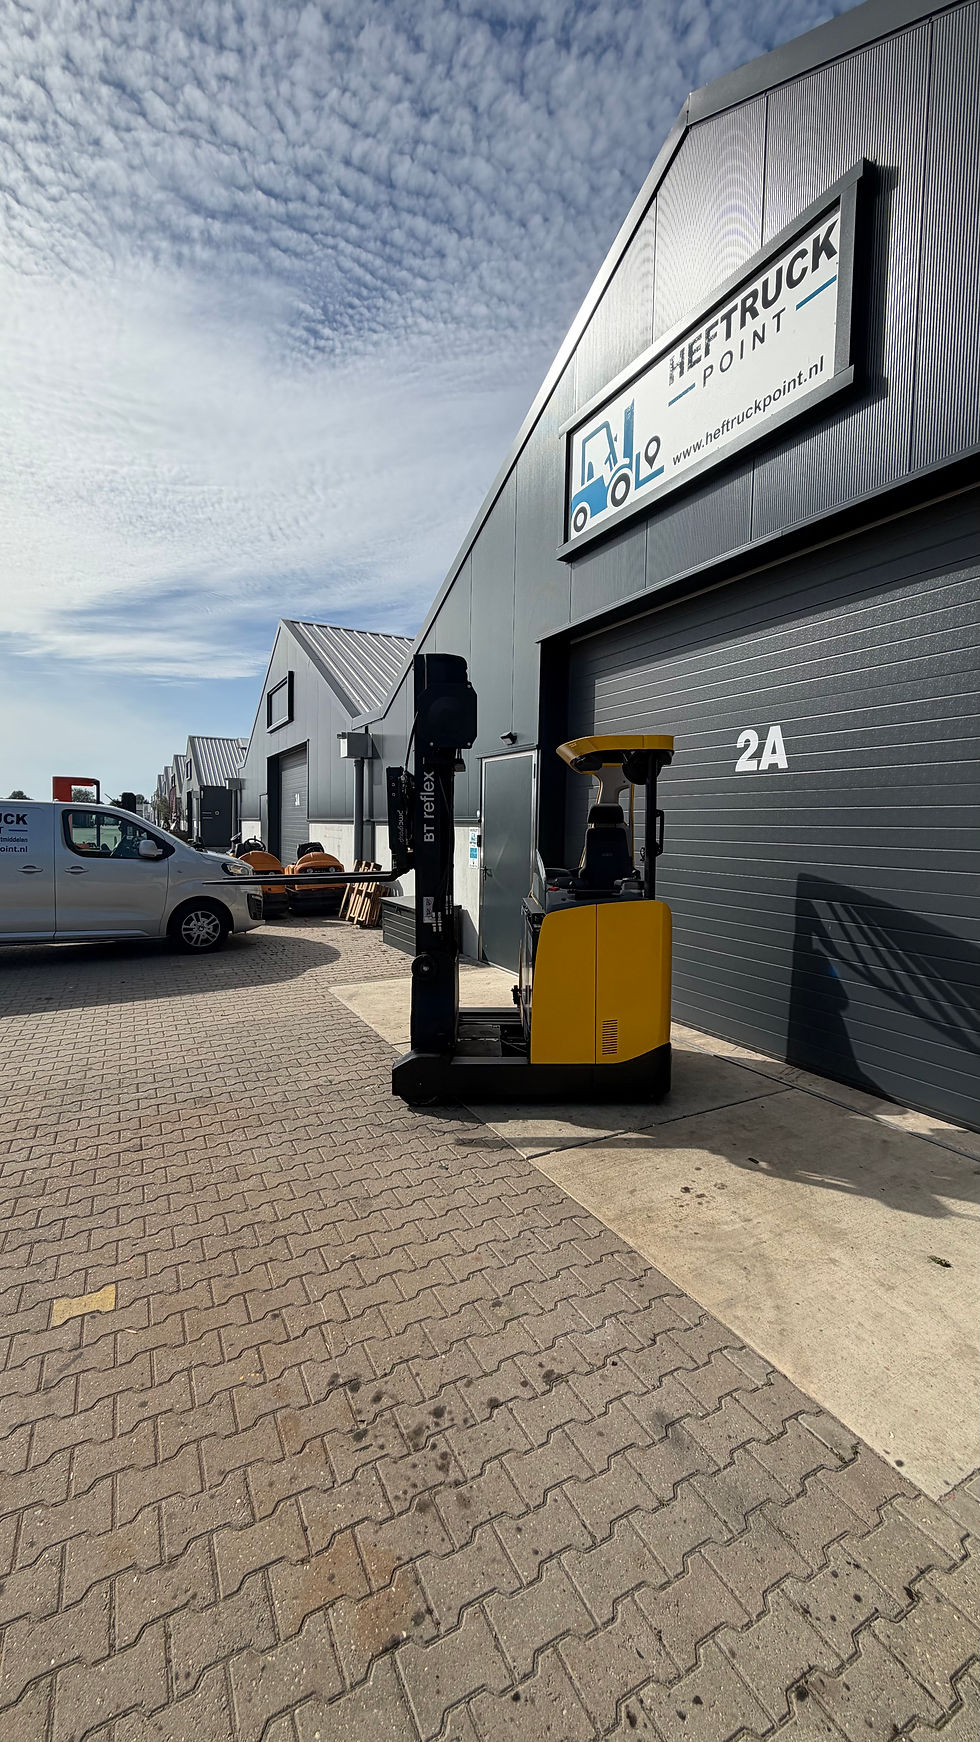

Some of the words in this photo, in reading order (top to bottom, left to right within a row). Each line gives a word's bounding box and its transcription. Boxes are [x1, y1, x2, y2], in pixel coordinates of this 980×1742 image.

[668, 219, 839, 386] HEFTRUCK
[703, 307, 786, 388] POINT
[672, 355, 824, 466] www.heftruckpoint.nl
[735, 725, 788, 772] 2A
[0, 812, 28, 825] CK
[420, 771, 435, 819] reflex
[423, 823, 435, 842] BT
